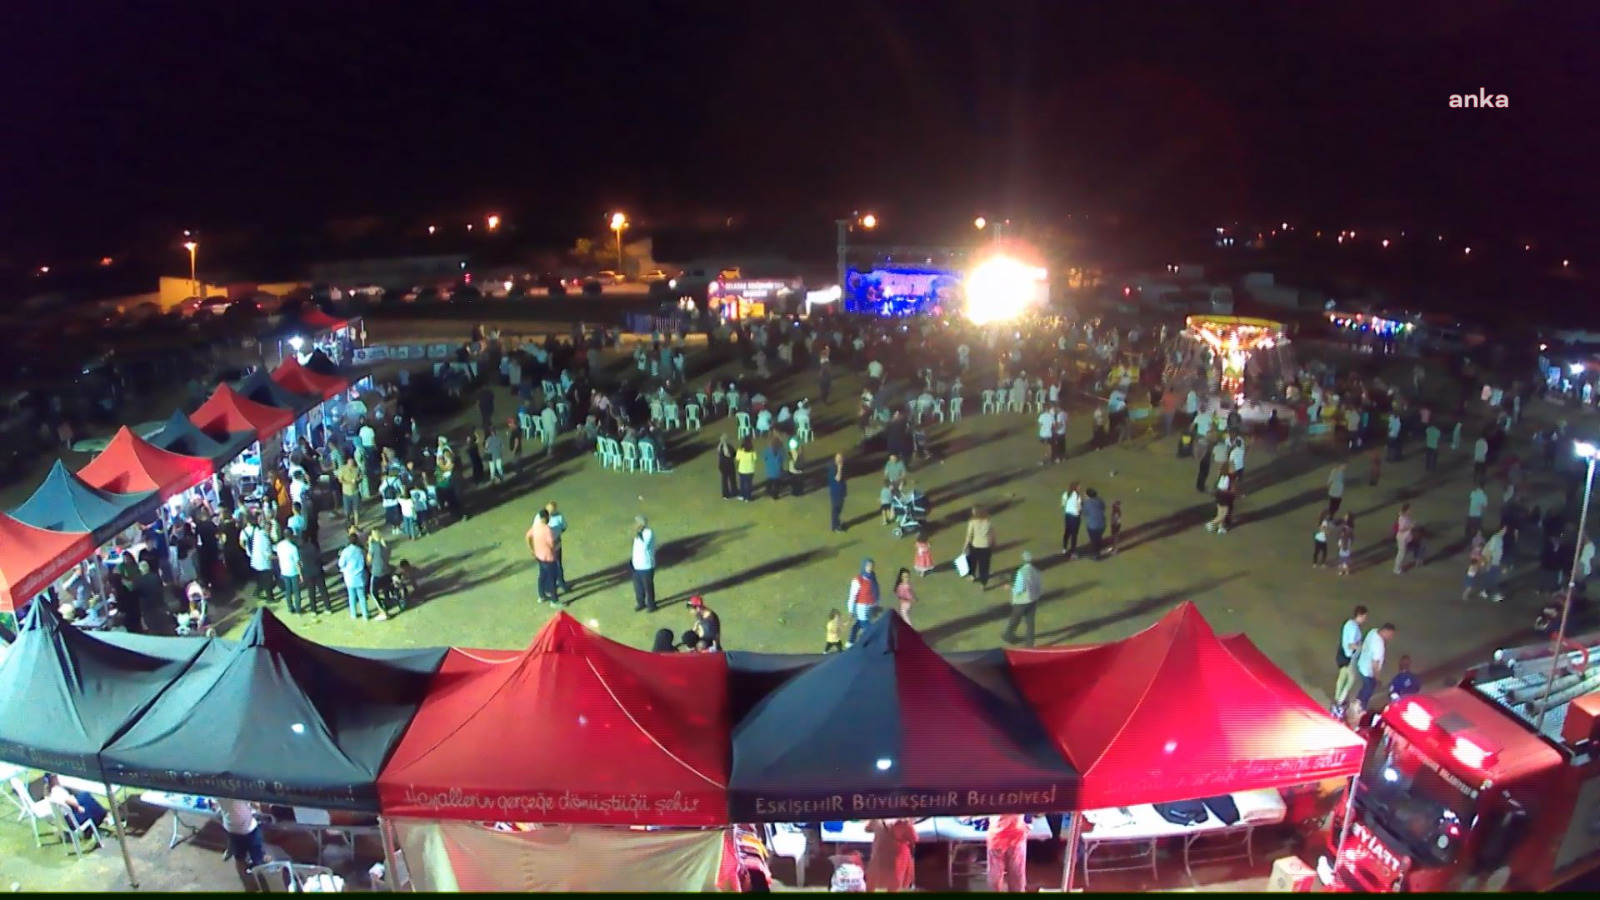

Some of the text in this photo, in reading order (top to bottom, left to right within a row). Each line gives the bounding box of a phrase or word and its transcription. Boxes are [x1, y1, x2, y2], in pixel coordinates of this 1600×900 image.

[405, 784, 494, 812] Hayallerin
[497, 792, 554, 815] gerçeğe
[654, 790, 700, 816] şehir
[755, 795, 844, 816] ESKİŞEHİR
